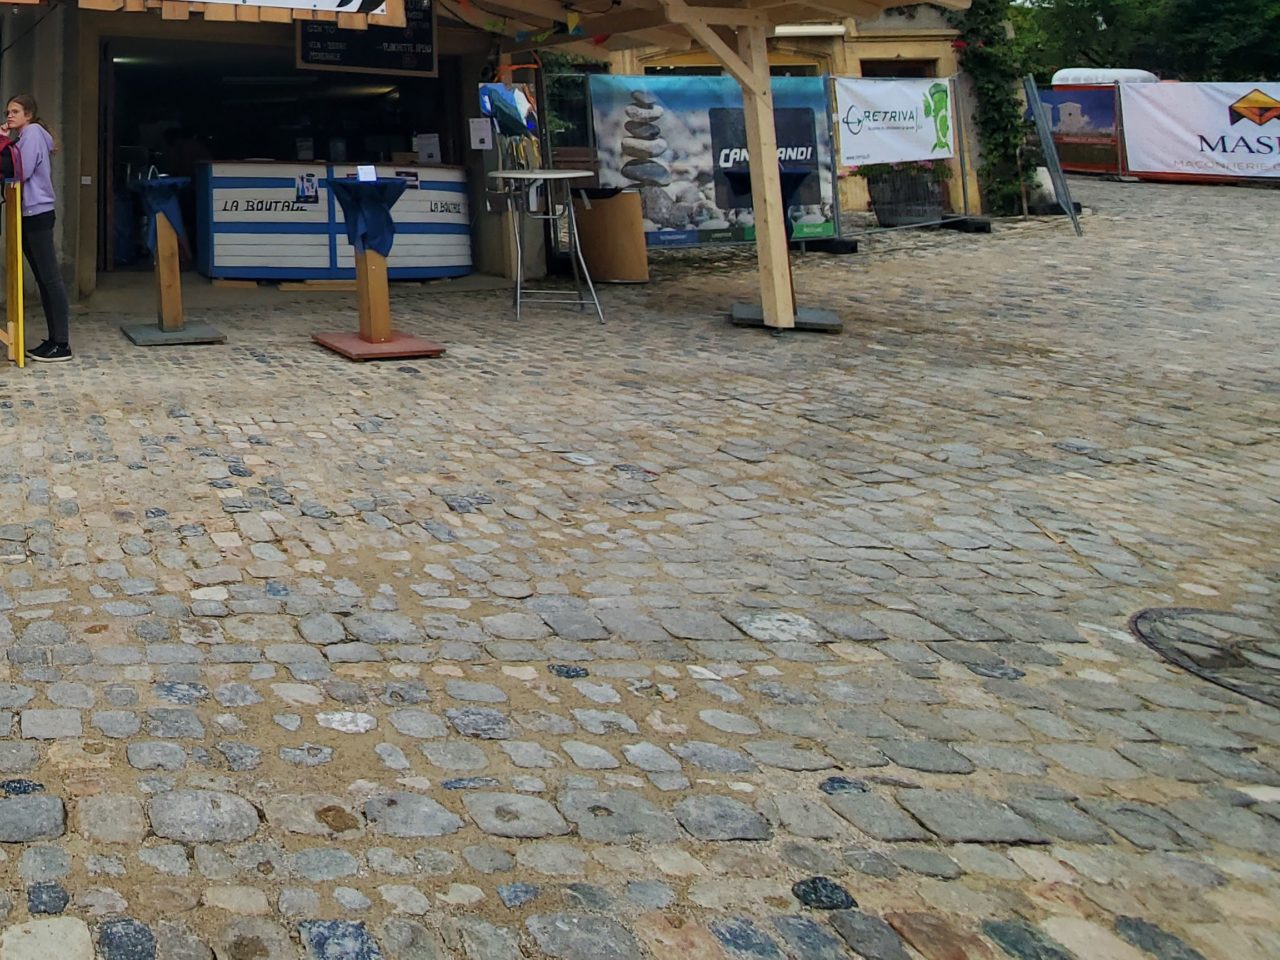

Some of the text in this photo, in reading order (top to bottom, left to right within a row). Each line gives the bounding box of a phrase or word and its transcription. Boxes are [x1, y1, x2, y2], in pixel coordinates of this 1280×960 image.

[863, 110, 915, 122] RETRIVA
[1197, 134, 1280, 155] MAS
[222, 200, 239, 211] LA
